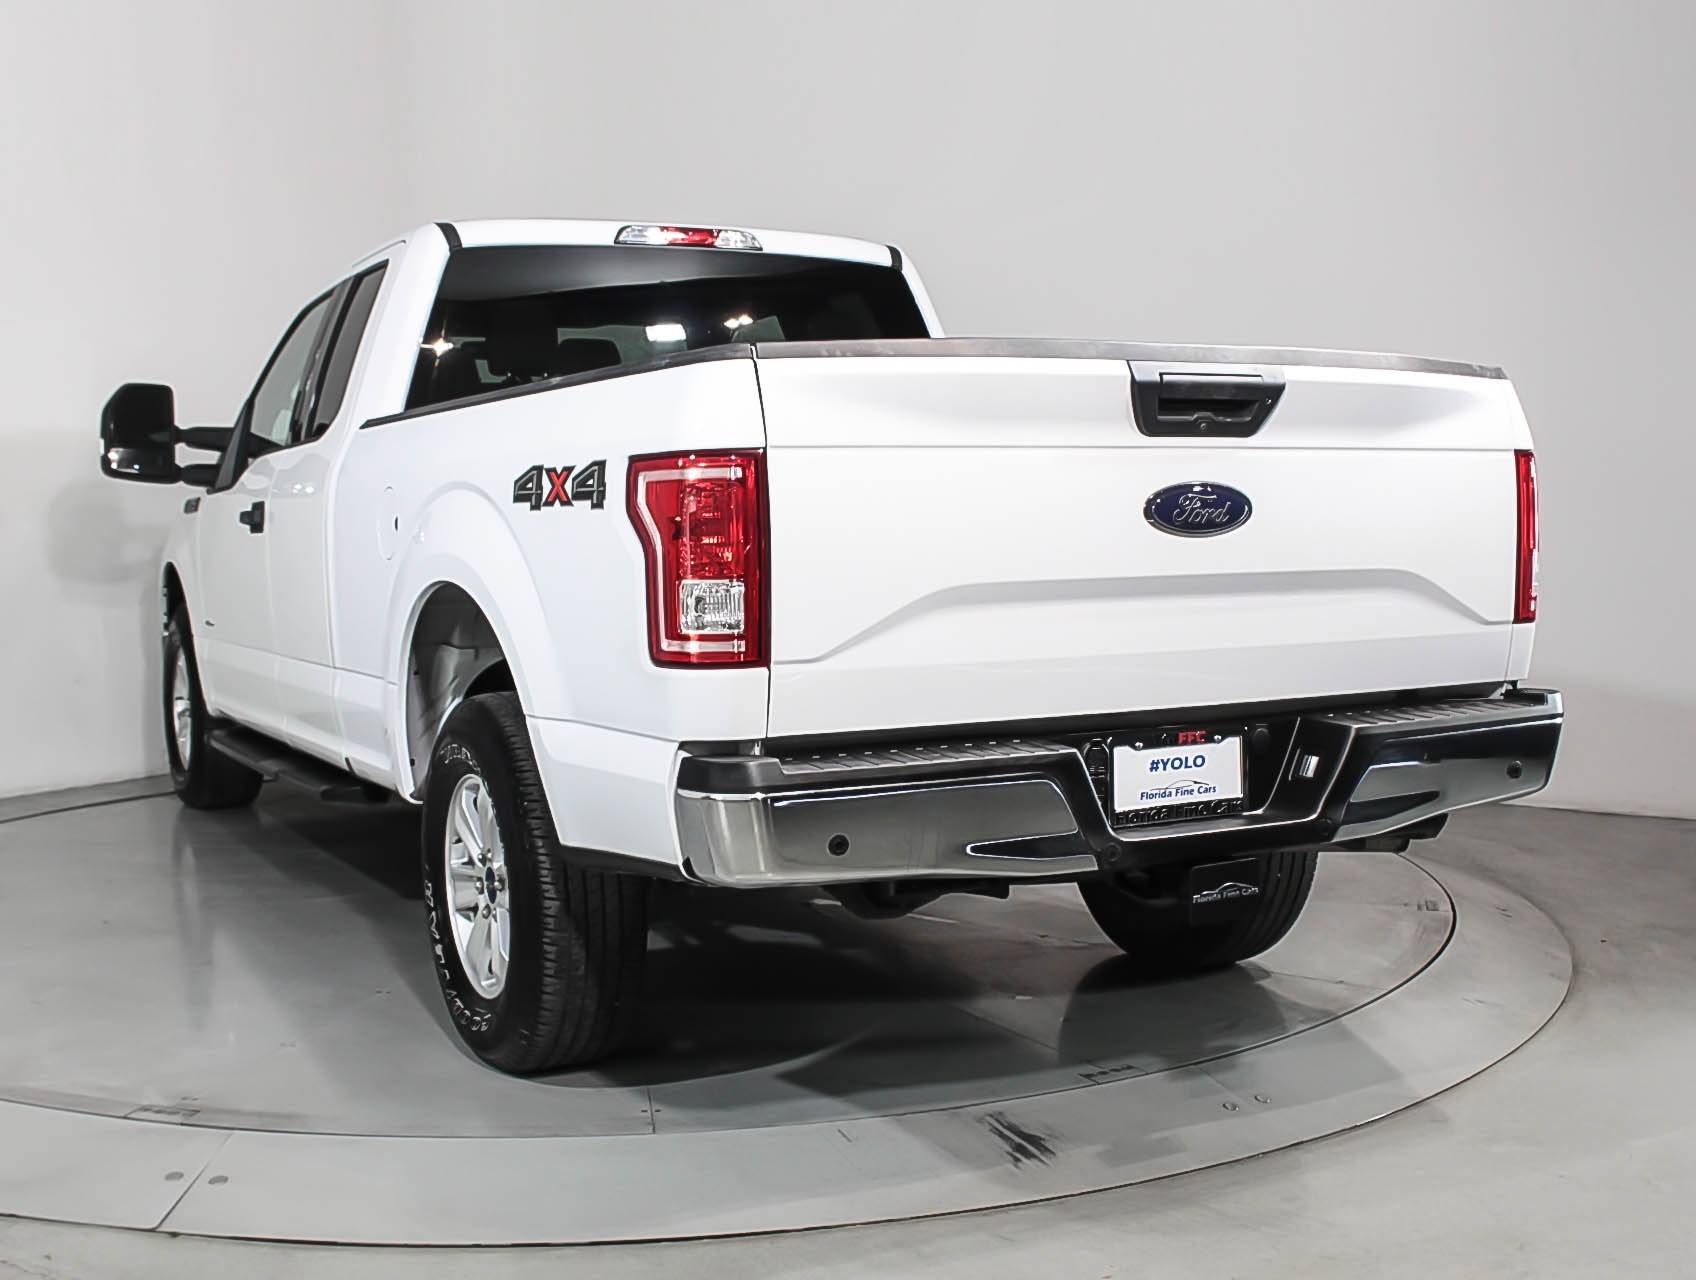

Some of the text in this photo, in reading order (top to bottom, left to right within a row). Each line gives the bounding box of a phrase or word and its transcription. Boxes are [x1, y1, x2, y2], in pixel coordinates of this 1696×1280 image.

[1172, 493, 1231, 523] Ford
[1178, 731, 1206, 745] FFC
[1149, 755, 1206, 772] #YOLO
[1140, 785, 1217, 801] Florida Fine Cars
